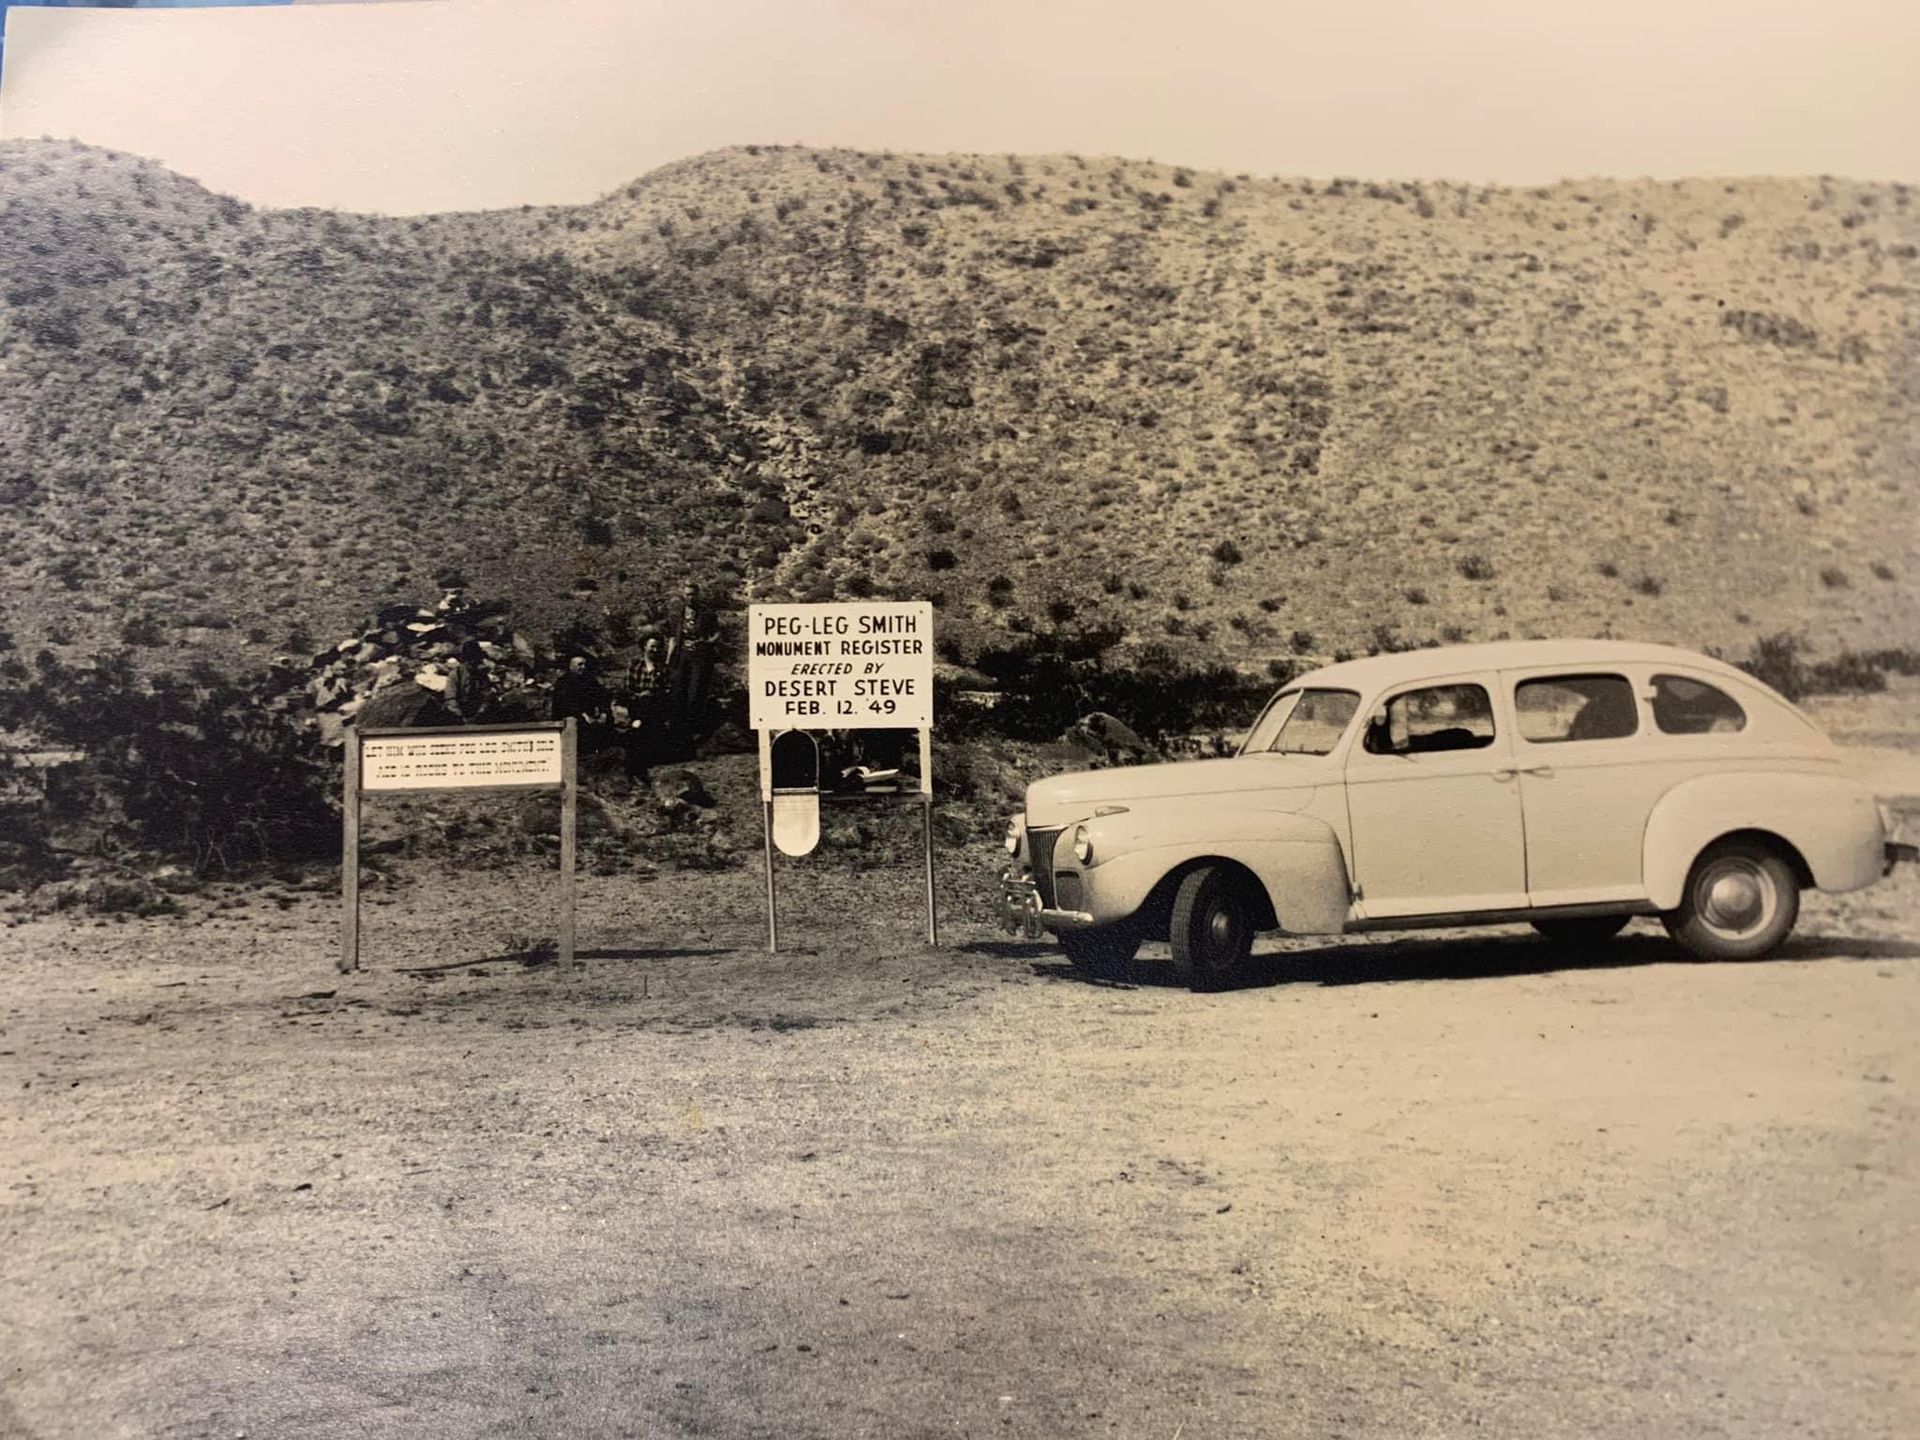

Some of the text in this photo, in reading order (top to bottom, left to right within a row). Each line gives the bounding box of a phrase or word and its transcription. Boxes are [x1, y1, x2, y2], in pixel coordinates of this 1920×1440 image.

[765, 615, 917, 635] PEG-LEG SMITH
[756, 639, 923, 656] MONUMENT REGISTER
[791, 662, 884, 675] ERECTED BY
[765, 679, 915, 697] DESERT STEVE
[785, 701, 826, 715] FEB.
